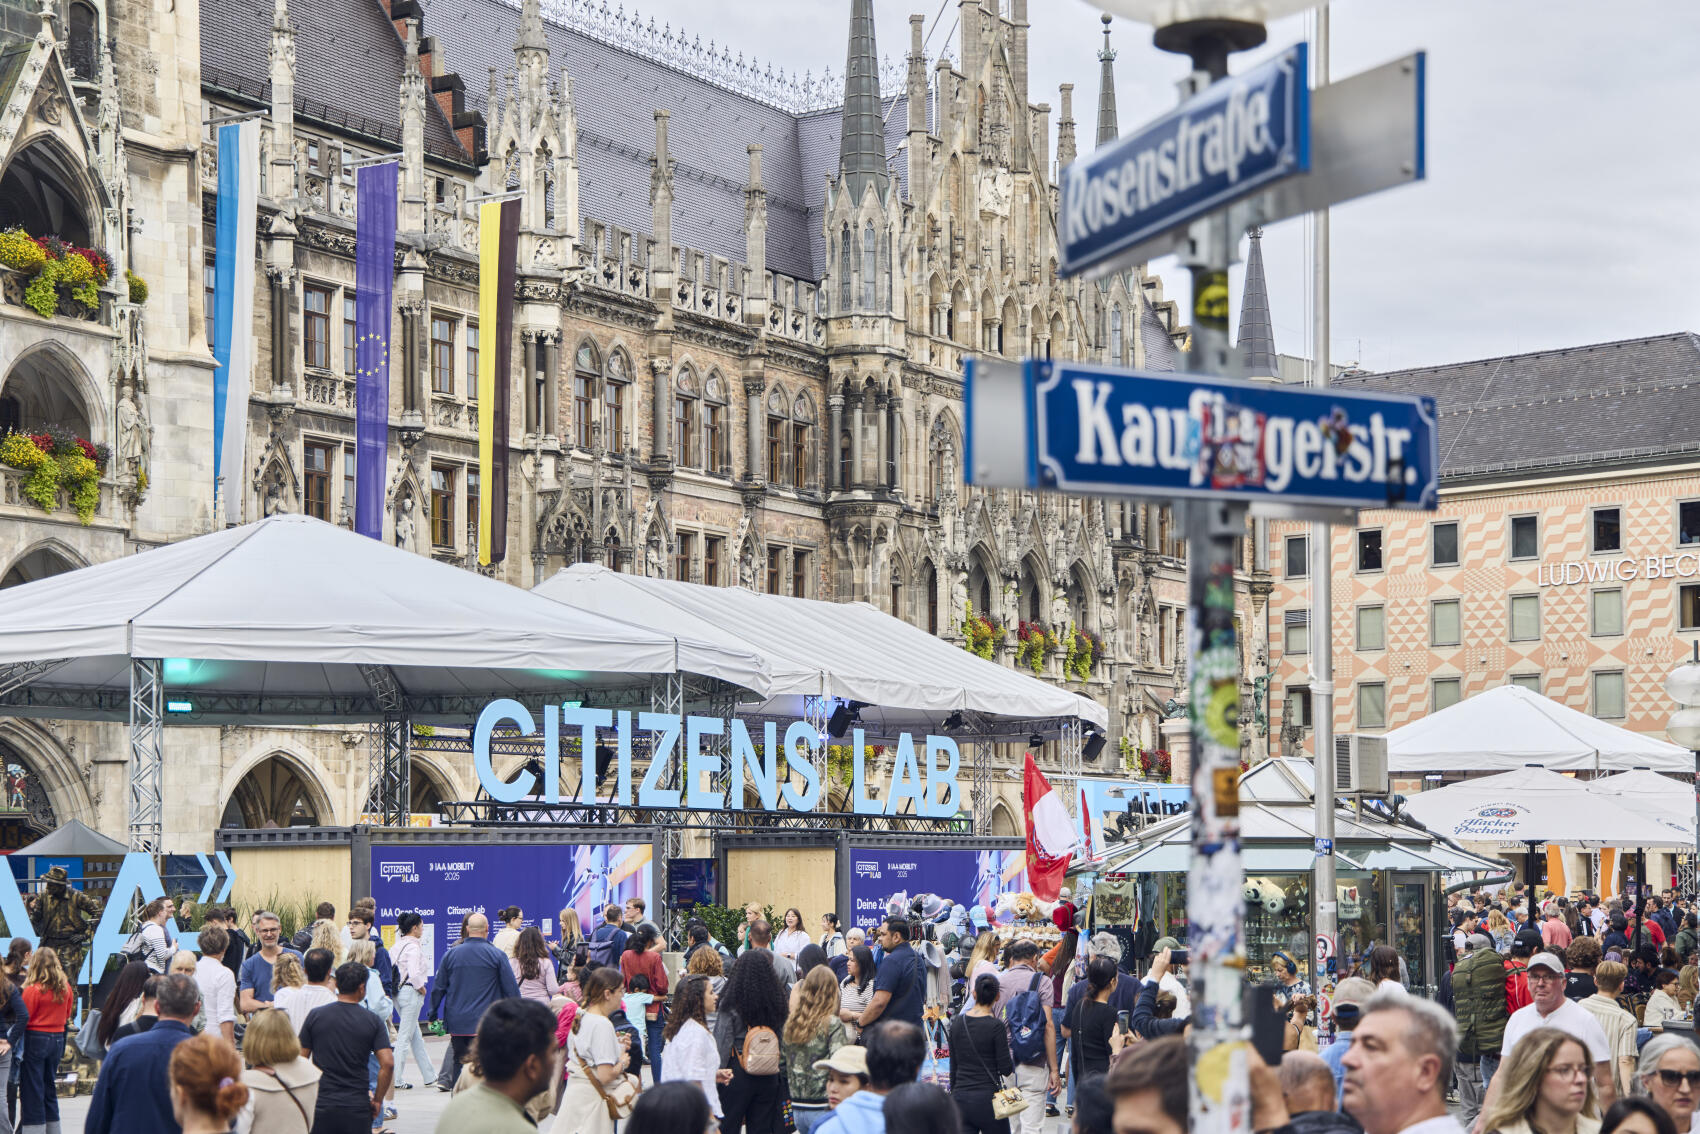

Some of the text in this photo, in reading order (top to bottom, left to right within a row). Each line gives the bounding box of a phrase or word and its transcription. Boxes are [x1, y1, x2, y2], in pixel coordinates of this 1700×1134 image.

[1064, 83, 1272, 245] Rosenstraße
[1538, 553, 1700, 587] LUDWIG BEC
[473, 698, 961, 819] CITIZENS LAB
[382, 865, 412, 874] CITIZENS
[435, 862, 475, 871] IAA MOBILITY
[405, 874, 420, 882] LAB
[444, 872, 460, 881] 2025
[473, 904, 486, 914] Lab
[856, 898, 878, 910] Deine
[381, 908, 394, 917] IAA
[856, 915, 880, 927] Ideen.
